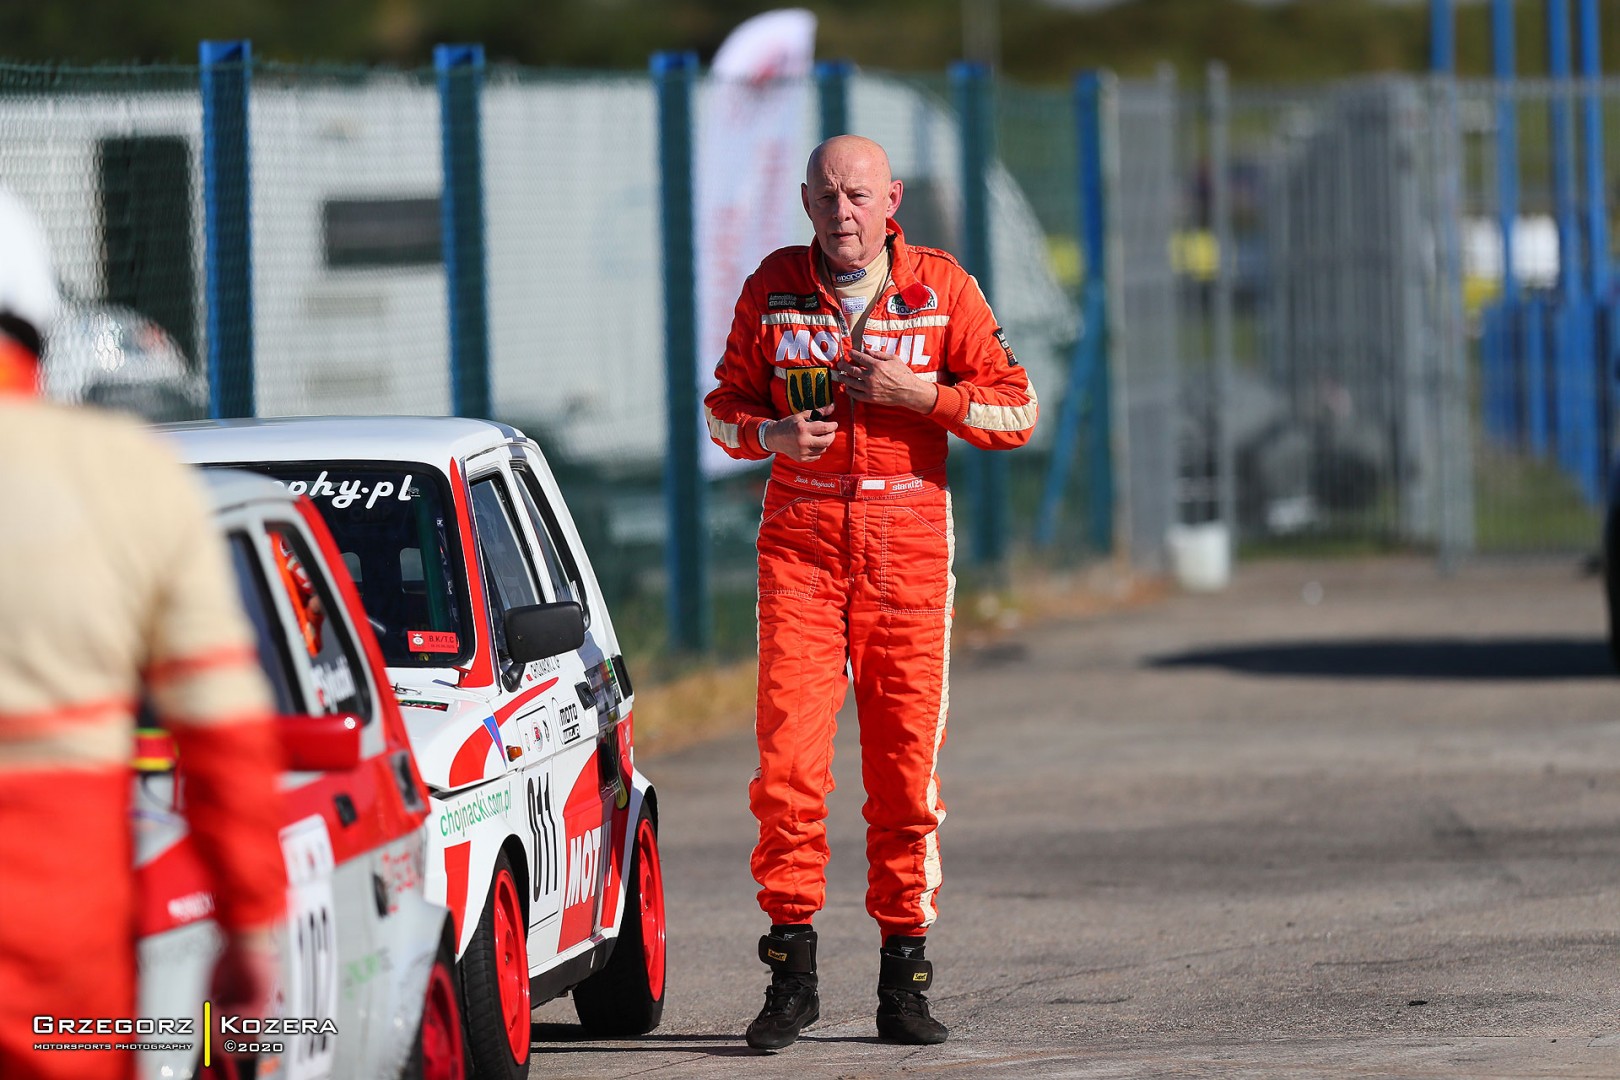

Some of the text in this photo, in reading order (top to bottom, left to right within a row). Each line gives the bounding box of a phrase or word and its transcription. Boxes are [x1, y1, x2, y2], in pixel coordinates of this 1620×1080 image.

[775, 329, 932, 367] MOTUL
[440, 781, 513, 838] chojnacki.com.pl
[527, 771, 558, 902] 011
